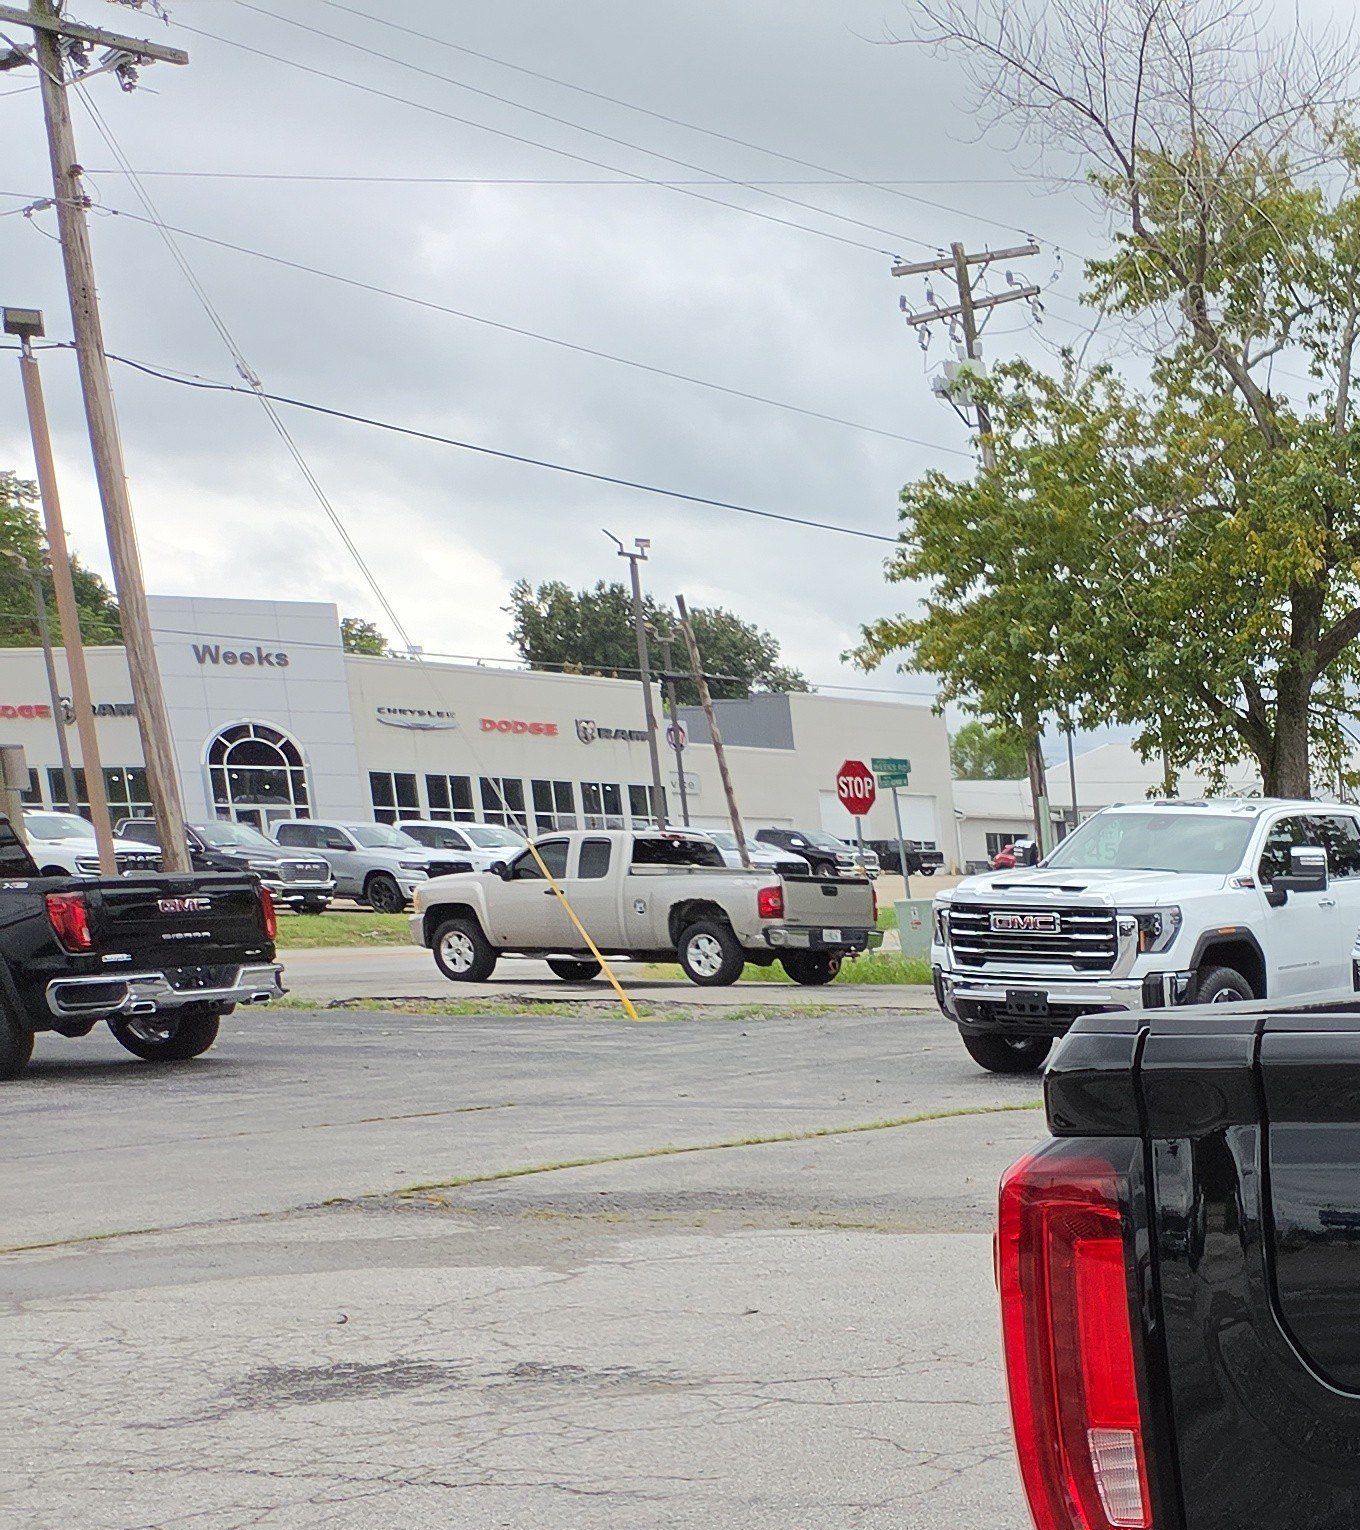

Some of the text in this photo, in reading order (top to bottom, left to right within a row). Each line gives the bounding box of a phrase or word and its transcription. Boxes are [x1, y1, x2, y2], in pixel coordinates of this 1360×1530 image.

[192, 644, 289, 667] Weeks
[376, 706, 456, 719] CHRYSLER
[479, 718, 559, 737] DODGE
[838, 776, 873, 798] STOP
[994, 915, 1054, 930] GMC
